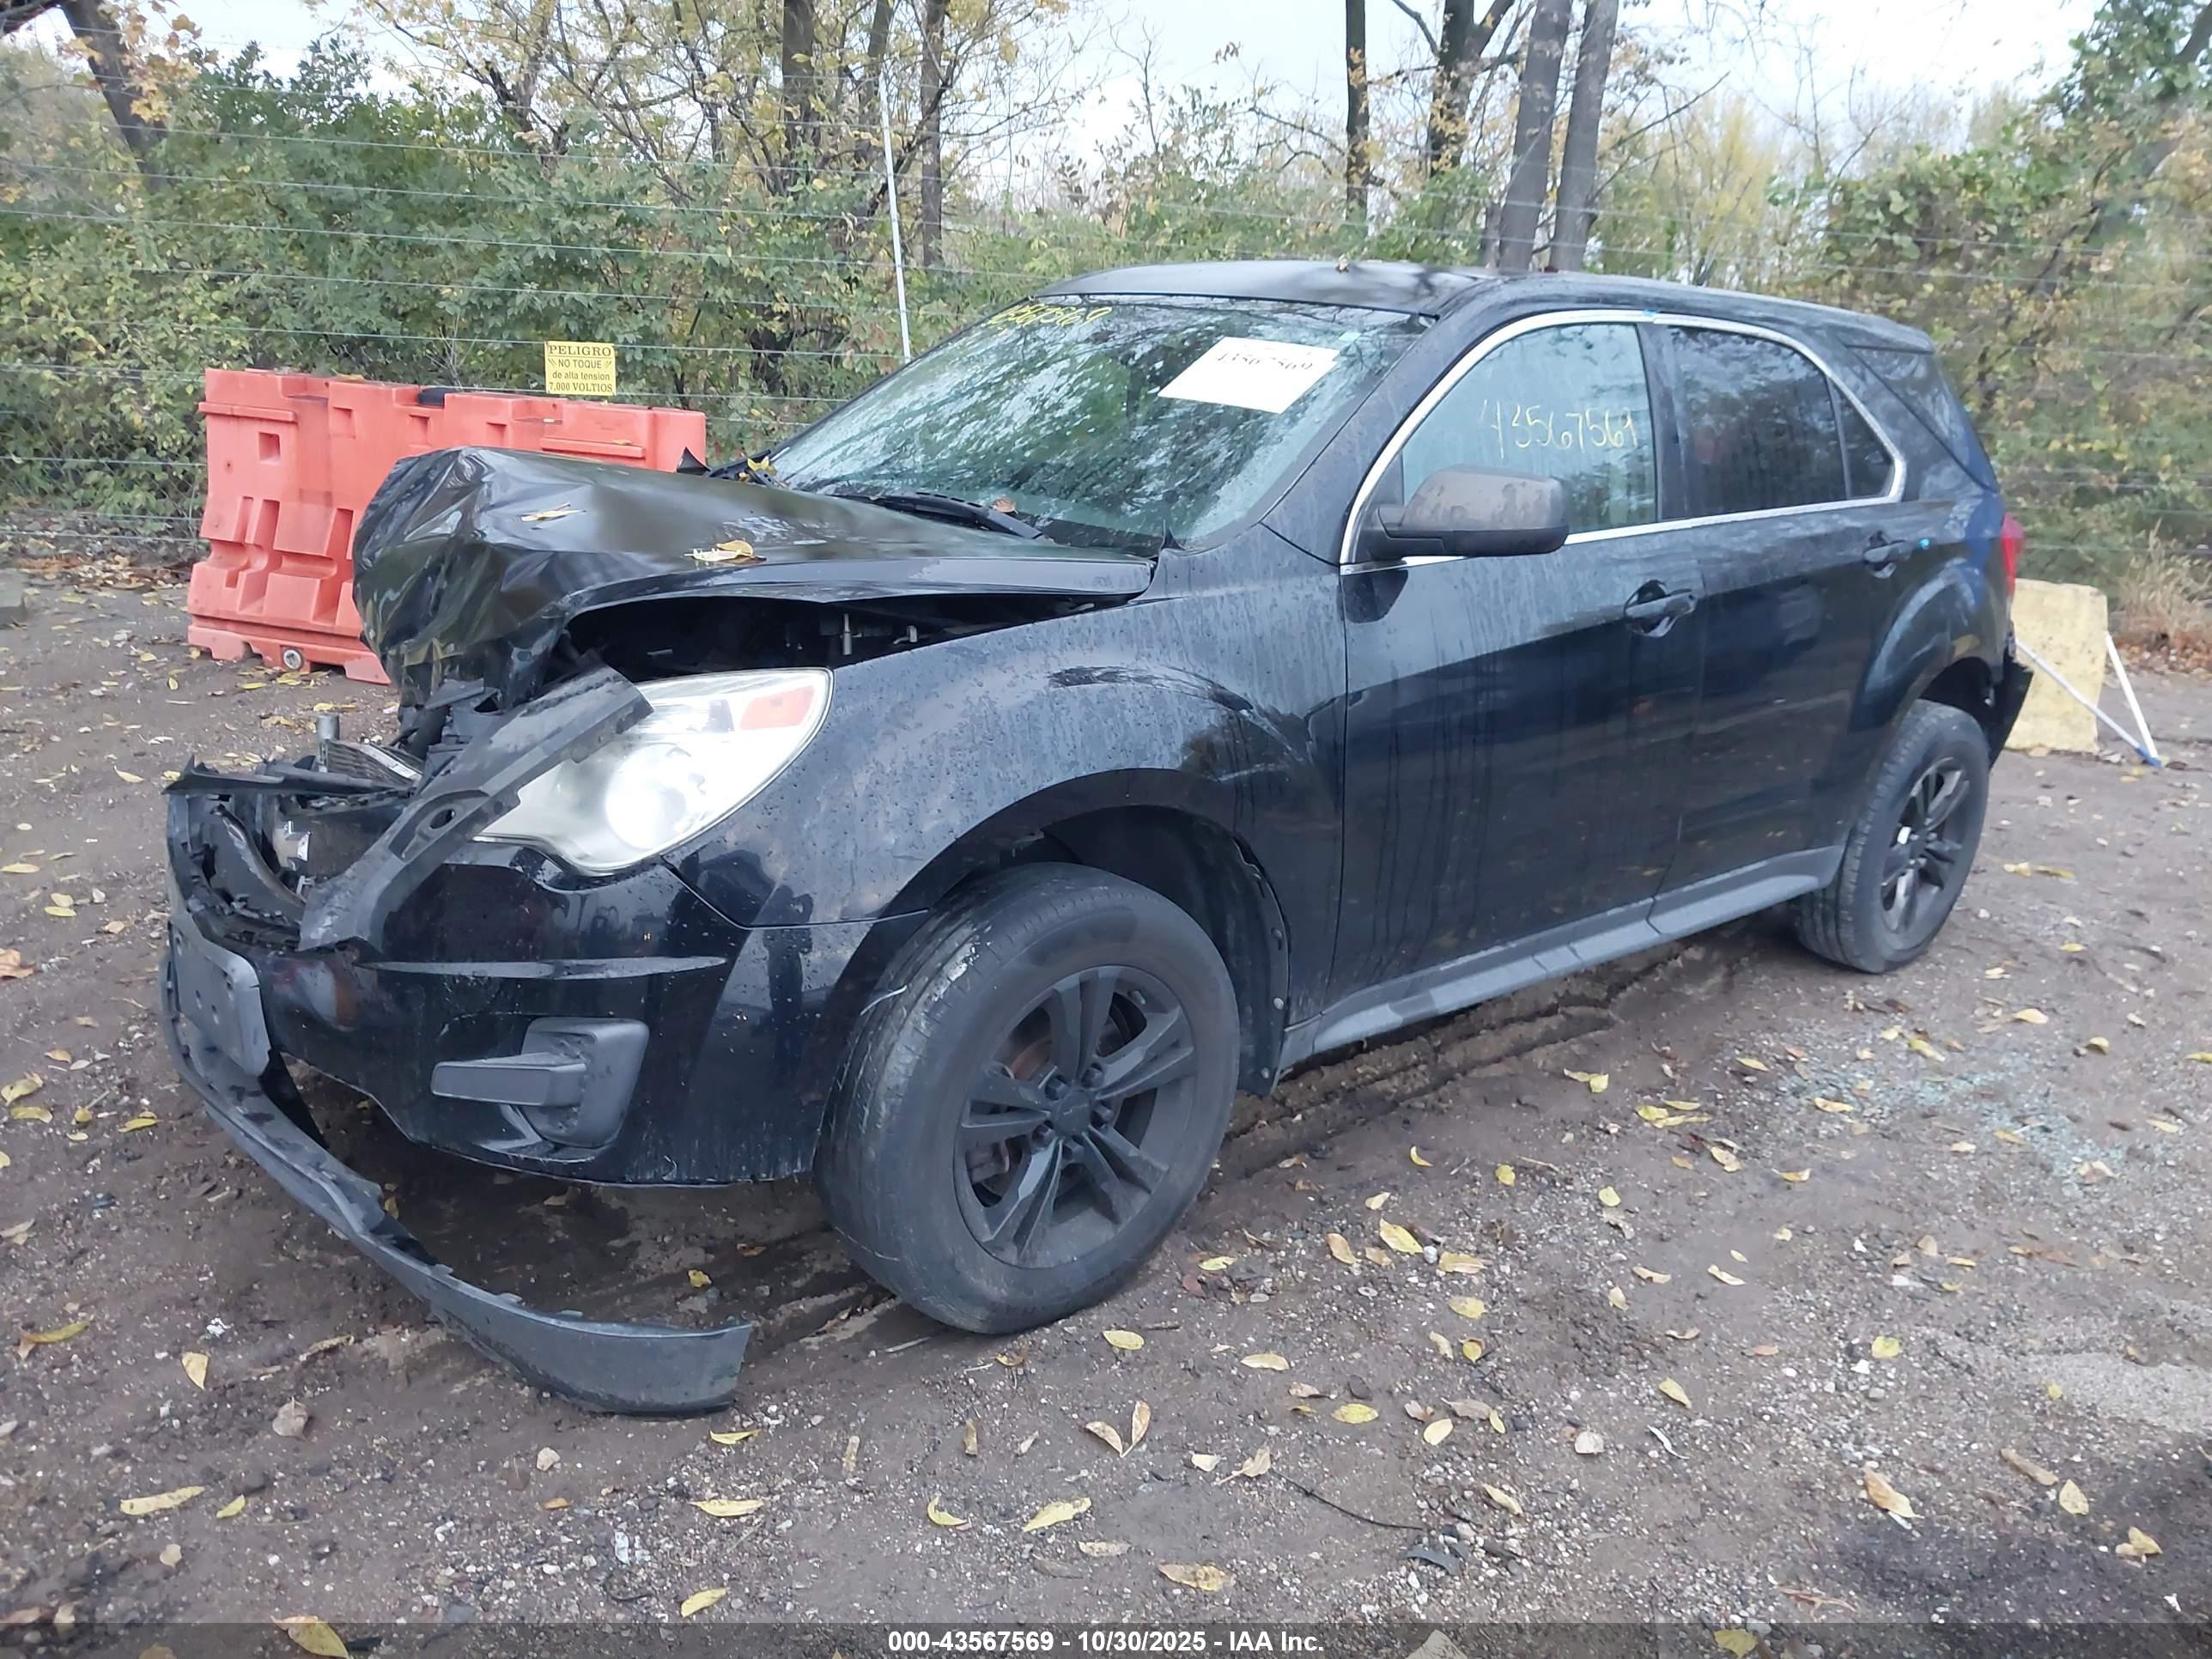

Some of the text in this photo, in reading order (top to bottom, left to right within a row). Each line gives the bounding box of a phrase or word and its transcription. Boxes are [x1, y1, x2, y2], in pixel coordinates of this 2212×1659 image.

[550, 345, 611, 356] PELIGRO
[558, 359, 602, 369] NO TOQUE
[564, 371, 579, 380] alta
[580, 372, 611, 381] tension
[550, 382, 613, 392] 7,000 VOLTIOS
